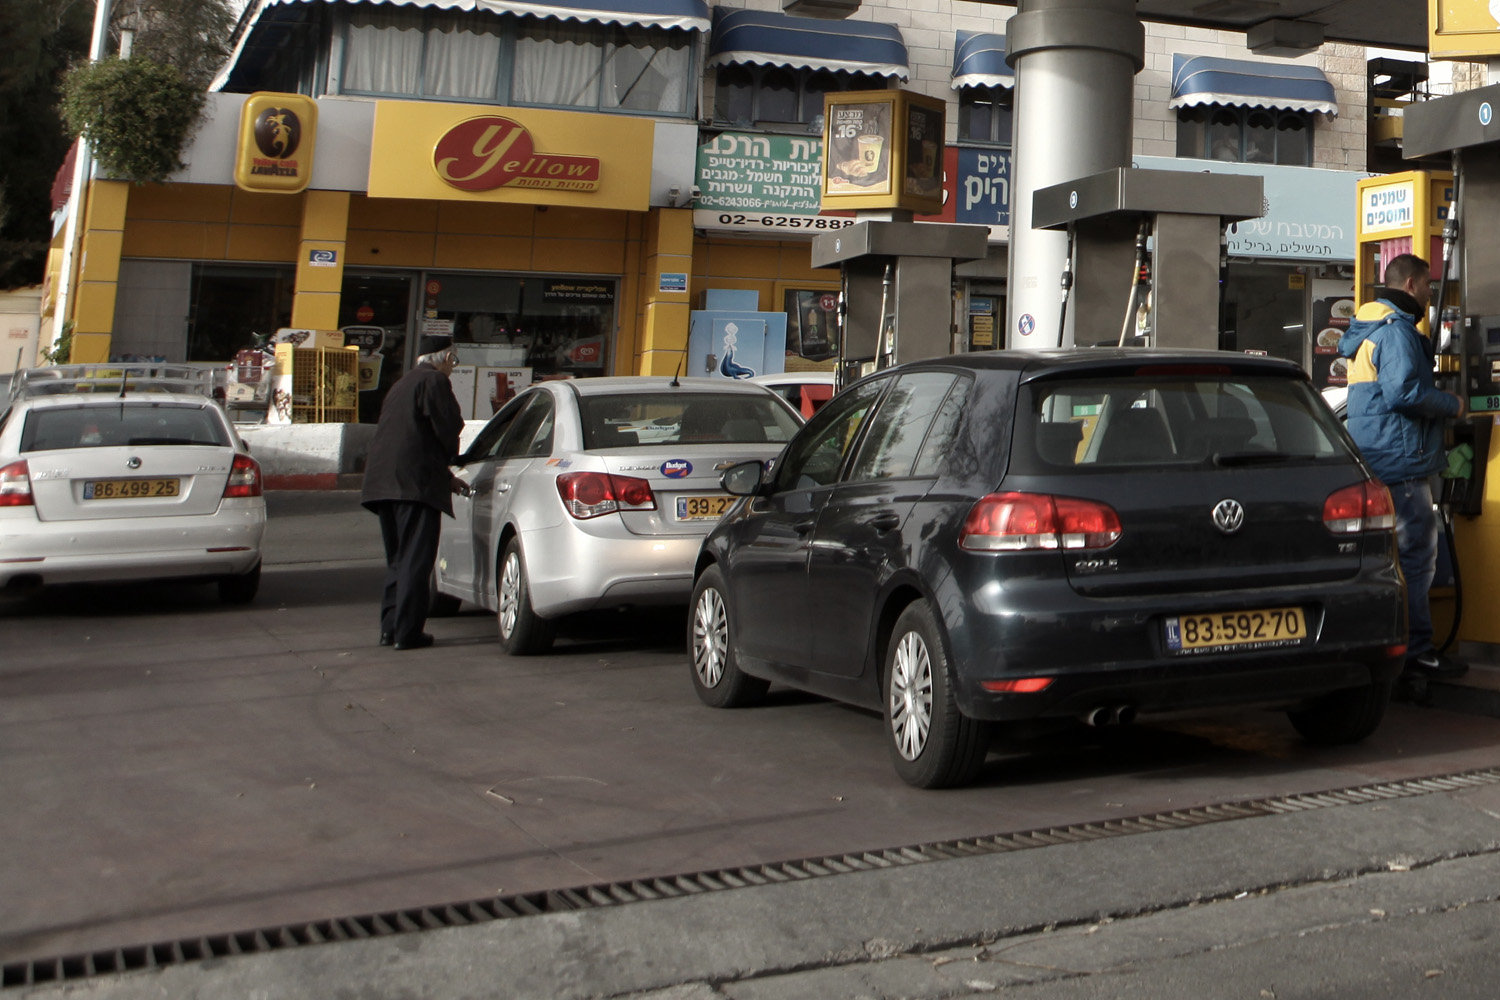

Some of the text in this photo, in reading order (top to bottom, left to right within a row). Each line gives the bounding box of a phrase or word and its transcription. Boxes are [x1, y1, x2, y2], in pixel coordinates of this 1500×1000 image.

[704, 135, 771, 158] הרכב
[978, 153, 1012, 174] גים
[701, 168, 738, 181] מגבים
[746, 169, 783, 183] חשמל
[517, 179, 594, 190] חנויות נוחות
[708, 181, 815, 199] התקנה ושרות
[1371, 189, 1407, 207] שמנים
[1367, 207, 1410, 226] ותוספים
[1277, 222, 1343, 240] המטבח
[1244, 238, 1271, 253] גריל
[1276, 241, 1332, 256] תבשילים,
[1486, 397, 1500, 409] 98
[665, 461, 688, 470] Budget
